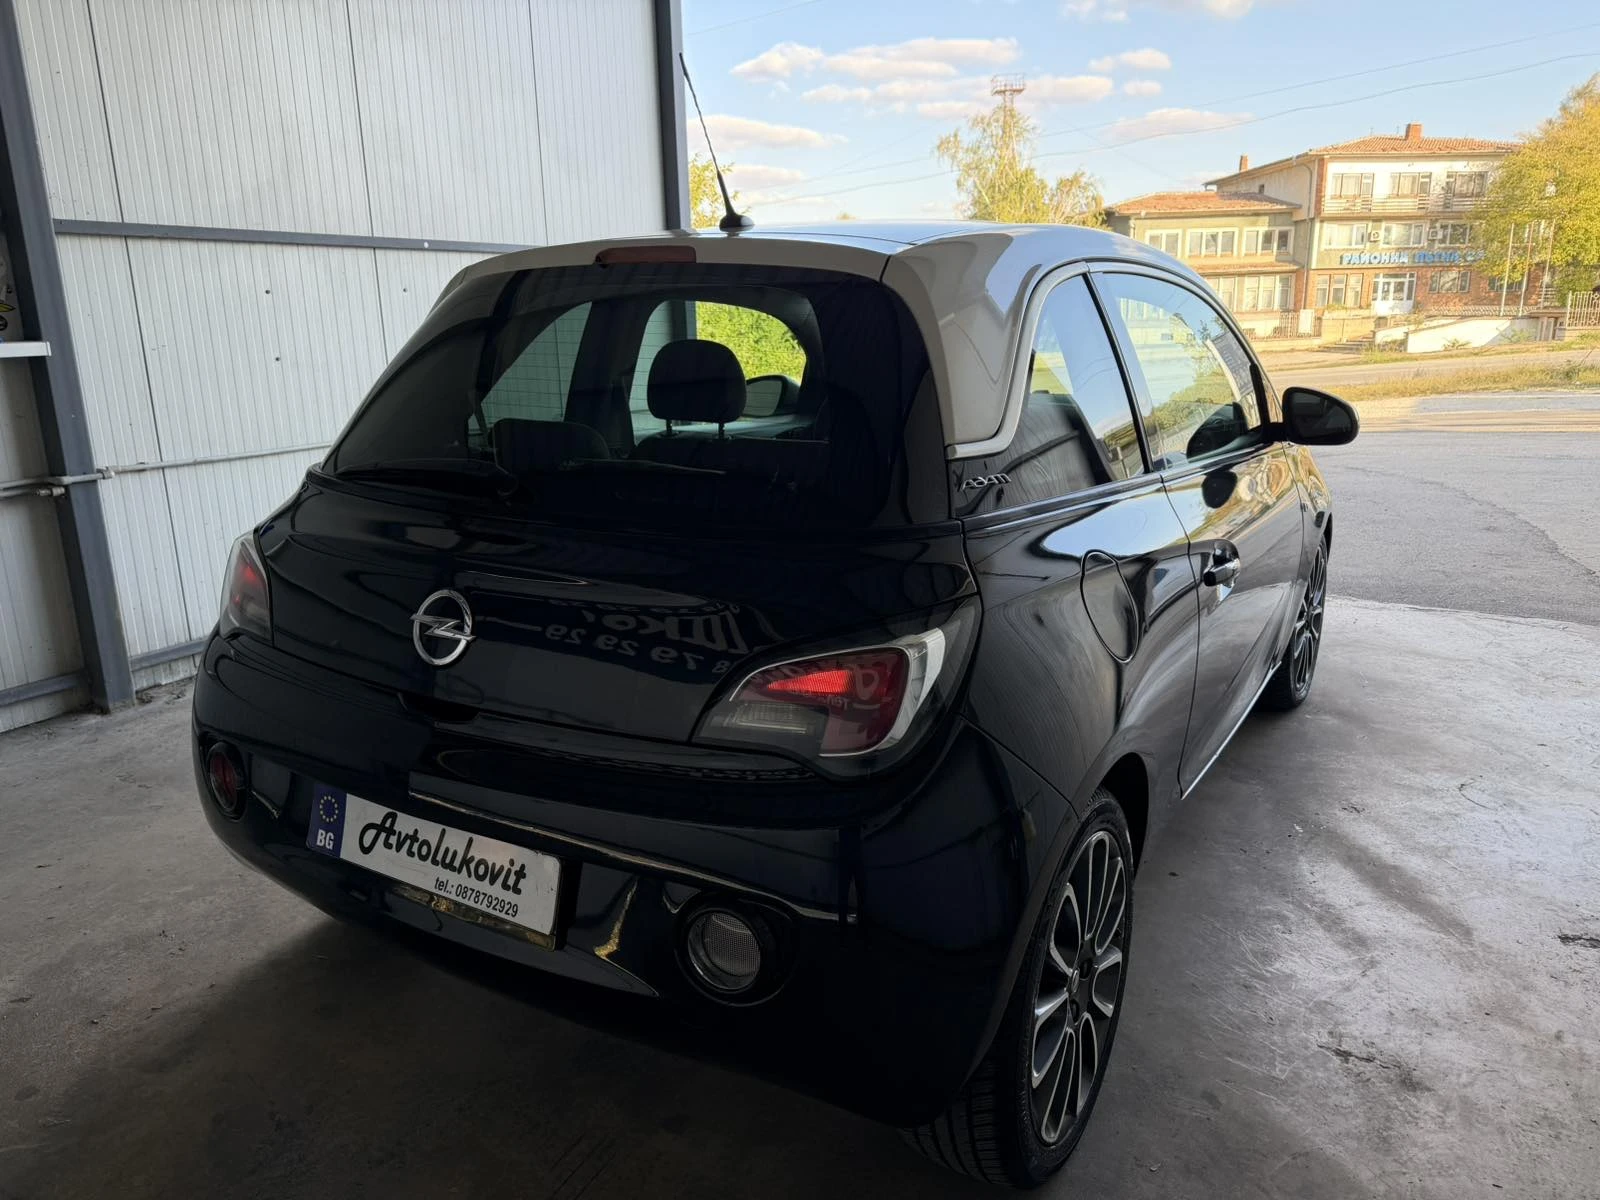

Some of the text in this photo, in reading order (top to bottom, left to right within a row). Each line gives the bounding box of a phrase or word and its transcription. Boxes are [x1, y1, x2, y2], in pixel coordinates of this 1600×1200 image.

[316, 828, 335, 850] BG
[358, 811, 527, 895] Avtolukovit
[434, 877, 519, 918] tel.: 0878792929
